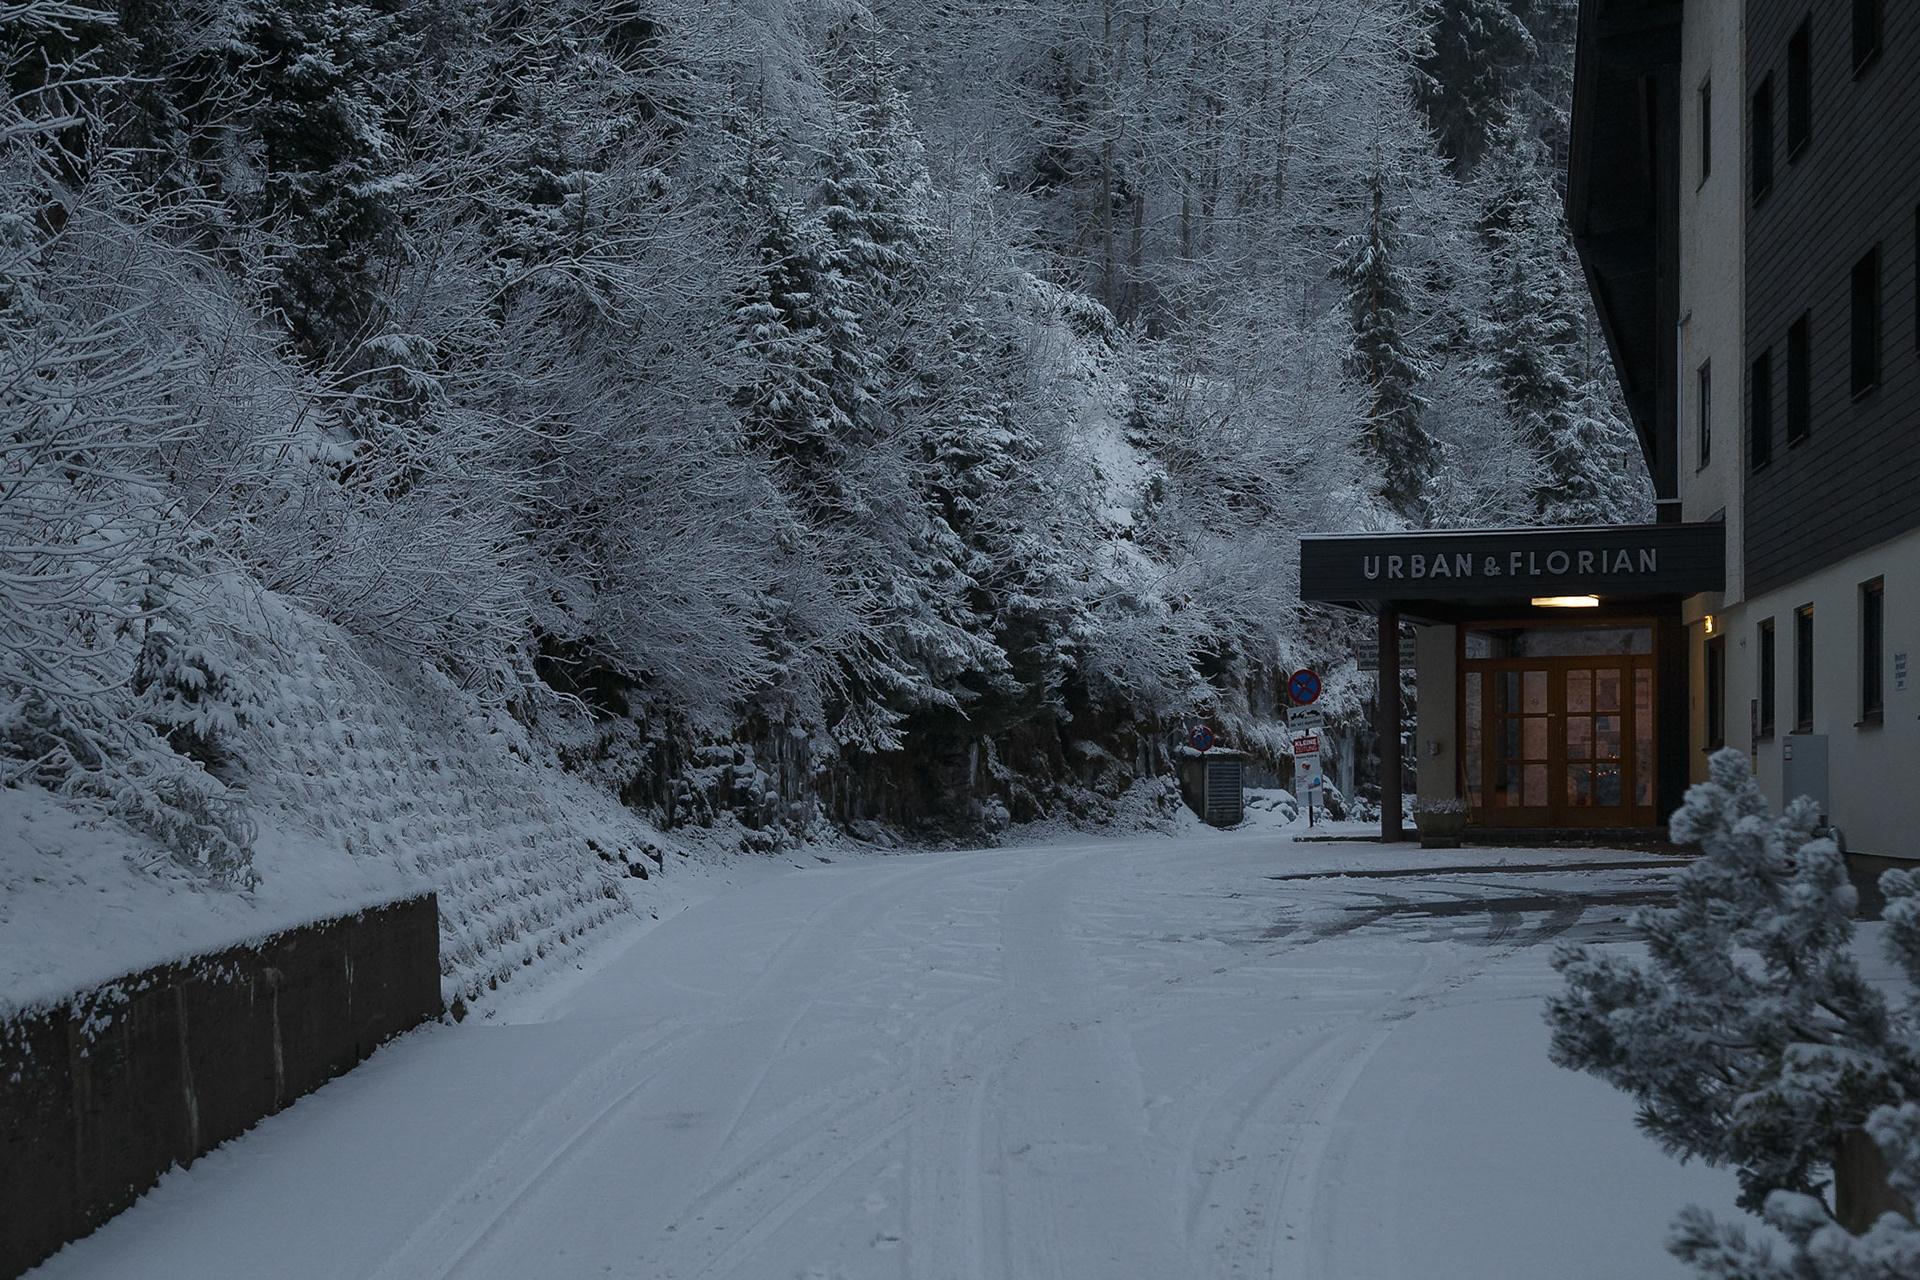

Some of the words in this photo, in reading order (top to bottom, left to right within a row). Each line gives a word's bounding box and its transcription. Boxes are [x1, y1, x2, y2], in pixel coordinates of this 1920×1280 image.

[1363, 554, 1472, 579] URBAN
[1484, 557, 1501, 576] &
[1509, 548, 1657, 575] FLORIAN
[1294, 738, 1317, 747] KLEINE
